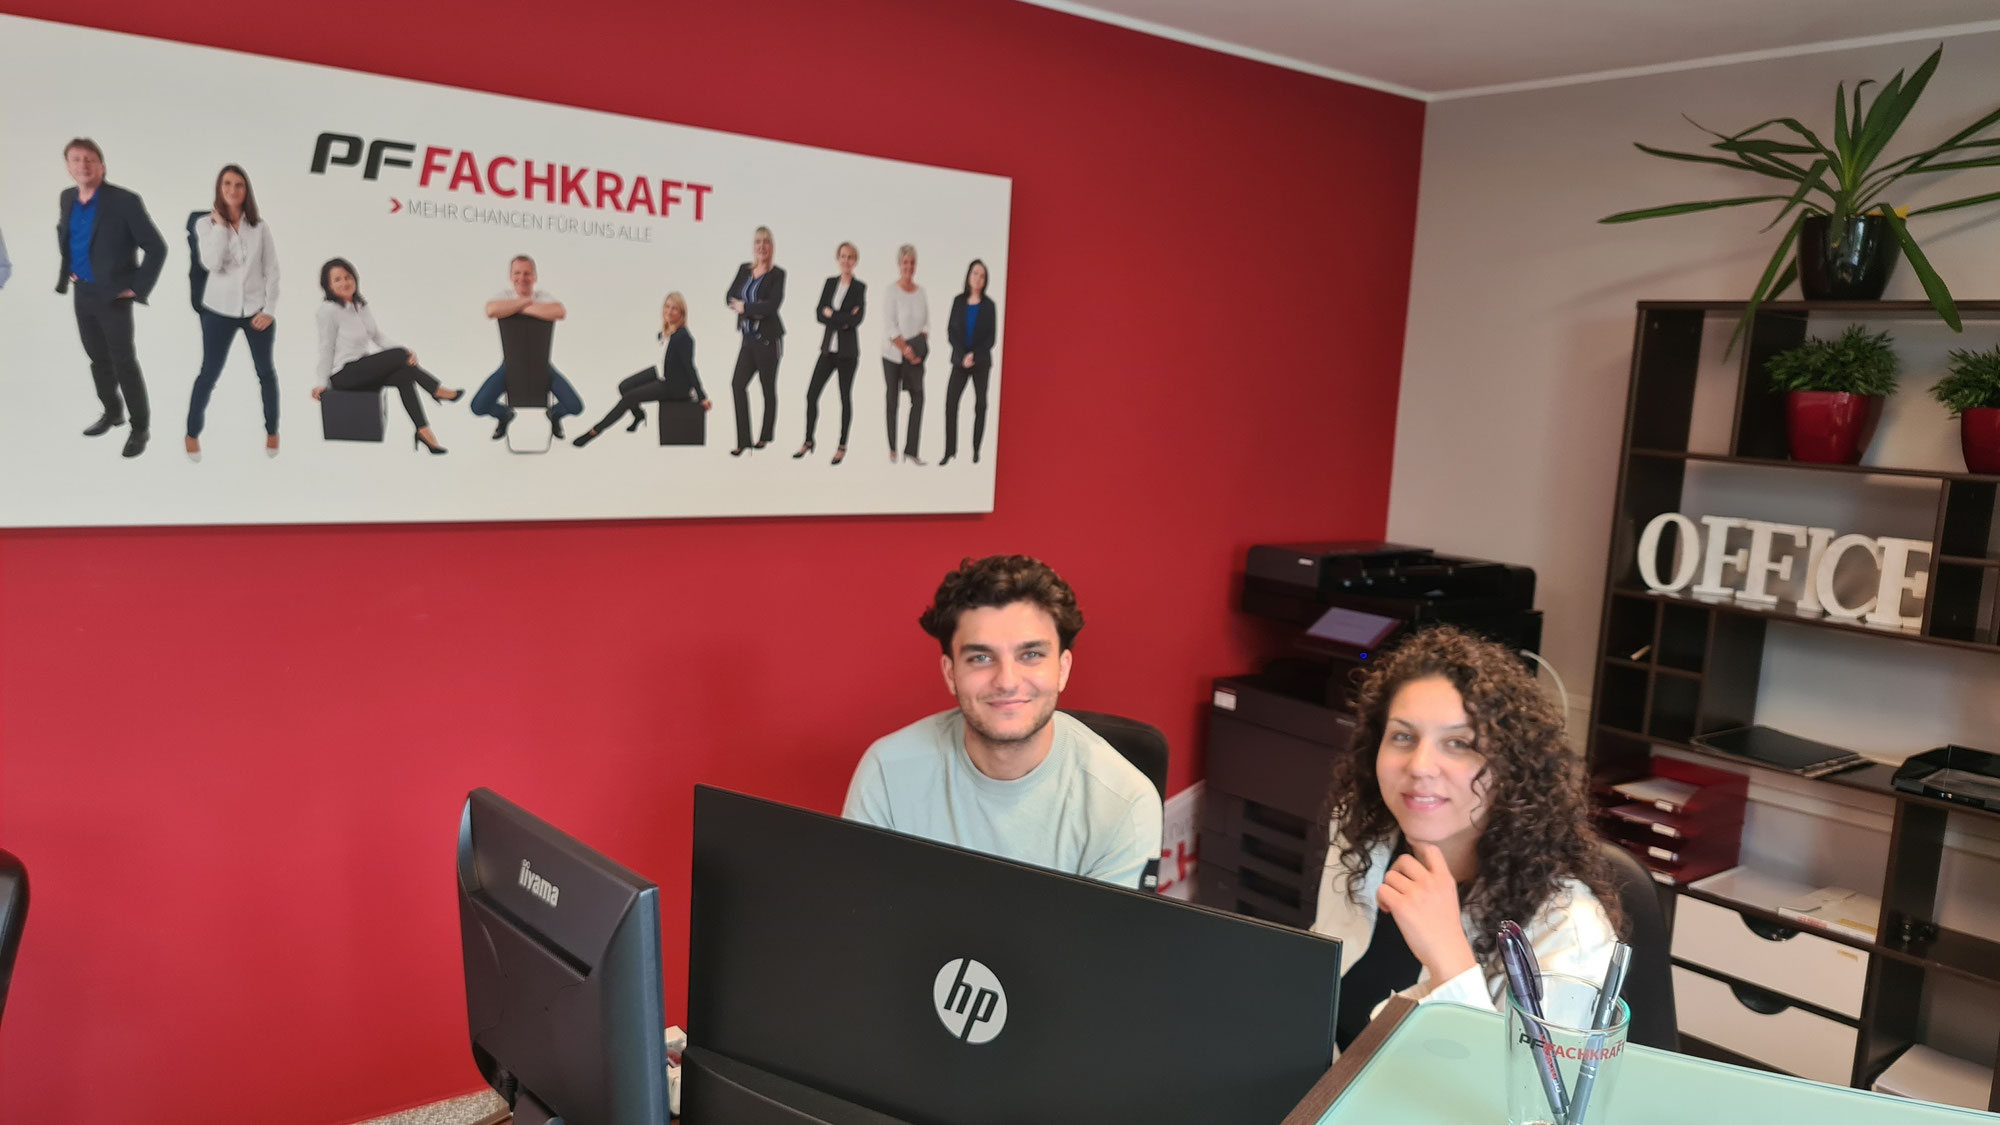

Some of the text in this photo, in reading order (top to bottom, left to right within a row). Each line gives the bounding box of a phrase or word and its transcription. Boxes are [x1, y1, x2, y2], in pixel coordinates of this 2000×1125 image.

[309, 132, 713, 222] PF FACHKRAFT
[408, 199, 653, 243] MEHR CHANCEN FÜR UNS ALLE
[1637, 512, 1933, 630] OFFICE
[518, 858, 560, 907] iiyama
[943, 957, 999, 1041] hp
[1519, 1032, 1545, 1050] PF
